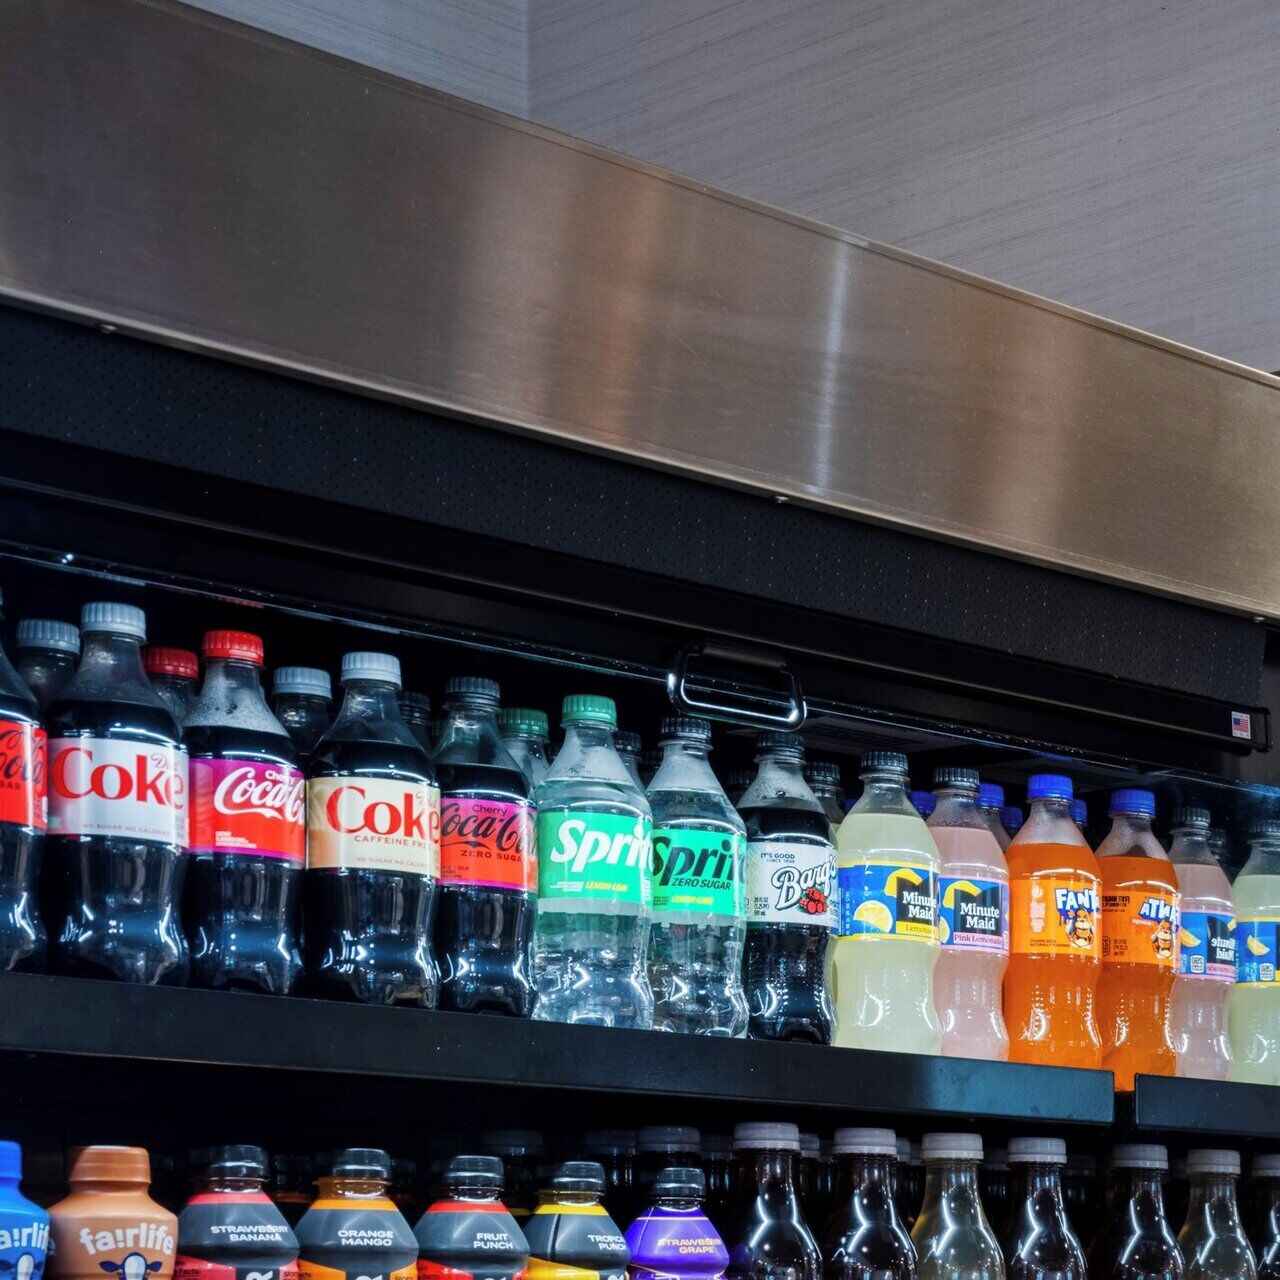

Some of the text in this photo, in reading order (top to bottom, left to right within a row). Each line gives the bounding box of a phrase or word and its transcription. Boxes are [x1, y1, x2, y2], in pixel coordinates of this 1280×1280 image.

[53, 746, 185, 810] Coke
[472, 804, 507, 817] Cherry
[461, 849, 492, 860] ZERO
[672, 877, 731, 891] ZERO SUGAR
[960, 902, 1000, 919] Minute
[966, 916, 995, 931] Maid
[210, 1224, 287, 1235] STRAWBERRY
[338, 1230, 394, 1239] ORANGE
[229, 1232, 282, 1242] BANANA
[341, 1237, 392, 1247] MANGO
[476, 1232, 508, 1242] FRUIT
[473, 1240, 513, 1249] PUNCH
[679, 1245, 714, 1254] GRAPE
